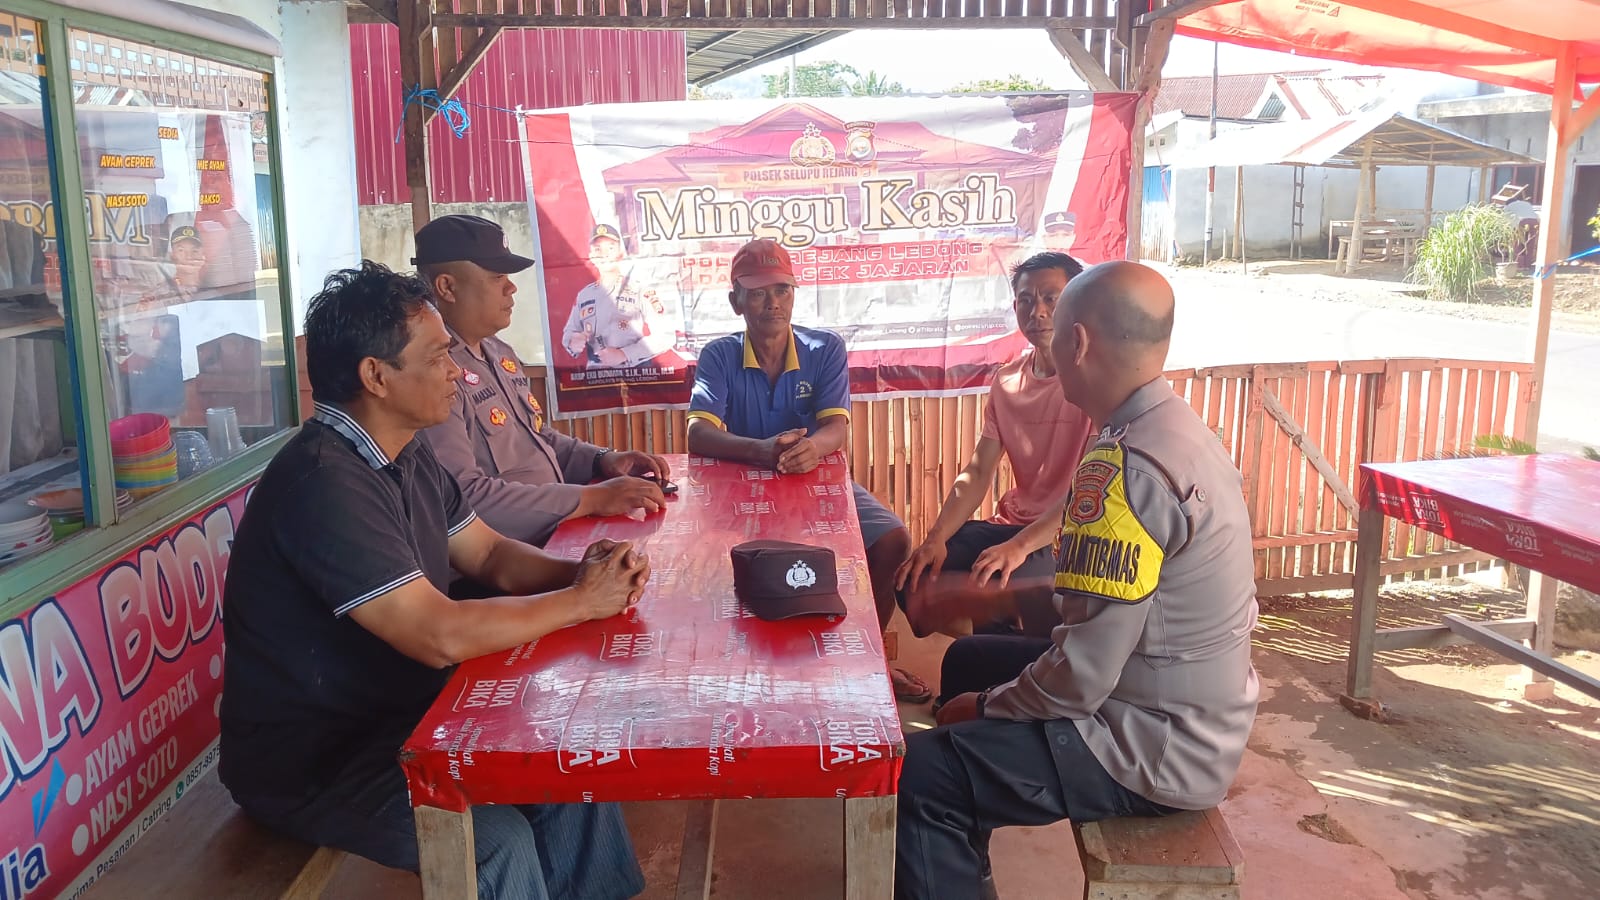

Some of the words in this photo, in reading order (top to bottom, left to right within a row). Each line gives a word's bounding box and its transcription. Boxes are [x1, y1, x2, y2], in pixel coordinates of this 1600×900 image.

[158, 126, 179, 140] SEDIA
[100, 154, 123, 168] AYAM
[124, 155, 156, 169] GEPREK
[196, 159, 208, 170] MIE
[208, 160, 225, 171] AYAM
[743, 169, 781, 182] POLSEK
[783, 168, 819, 181] SELUPU
[822, 166, 857, 179] REJANG
[105, 194, 126, 208] NASI
[126, 193, 147, 207] SOTO
[200, 193, 221, 206] BAKSO
[636, 186, 848, 249] Minggu
[860, 175, 1017, 233] Kasih
[888, 241, 984, 260] LEBONG
[856, 261, 970, 279] JAJARAN
[1412, 496, 1439, 511] BIKA
[1413, 507, 1441, 523] TORA
[609, 633, 633, 658] BIKA
[632, 632, 655, 658] TORA
[820, 632, 845, 657] BIKA
[842, 630, 866, 657] TORA
[463, 679, 489, 709] BIKA
[489, 676, 523, 708] TORA
[86, 720, 137, 797] AYAM
[138, 668, 199, 745] GEPREK
[596, 723, 621, 766] TORA
[827, 720, 855, 765] BIKA
[852, 718, 882, 764] TORA
[463, 747, 476, 767] Hati
[568, 725, 593, 768] BIKA
[722, 744, 736, 763] Hati
[447, 759, 464, 782] Kopi
[706, 755, 721, 776] Kopi
[89, 776, 133, 845] NASI
[136, 735, 178, 801] SOTO
[97, 832, 136, 878] Pesanan
[142, 795, 172, 832] Catring
